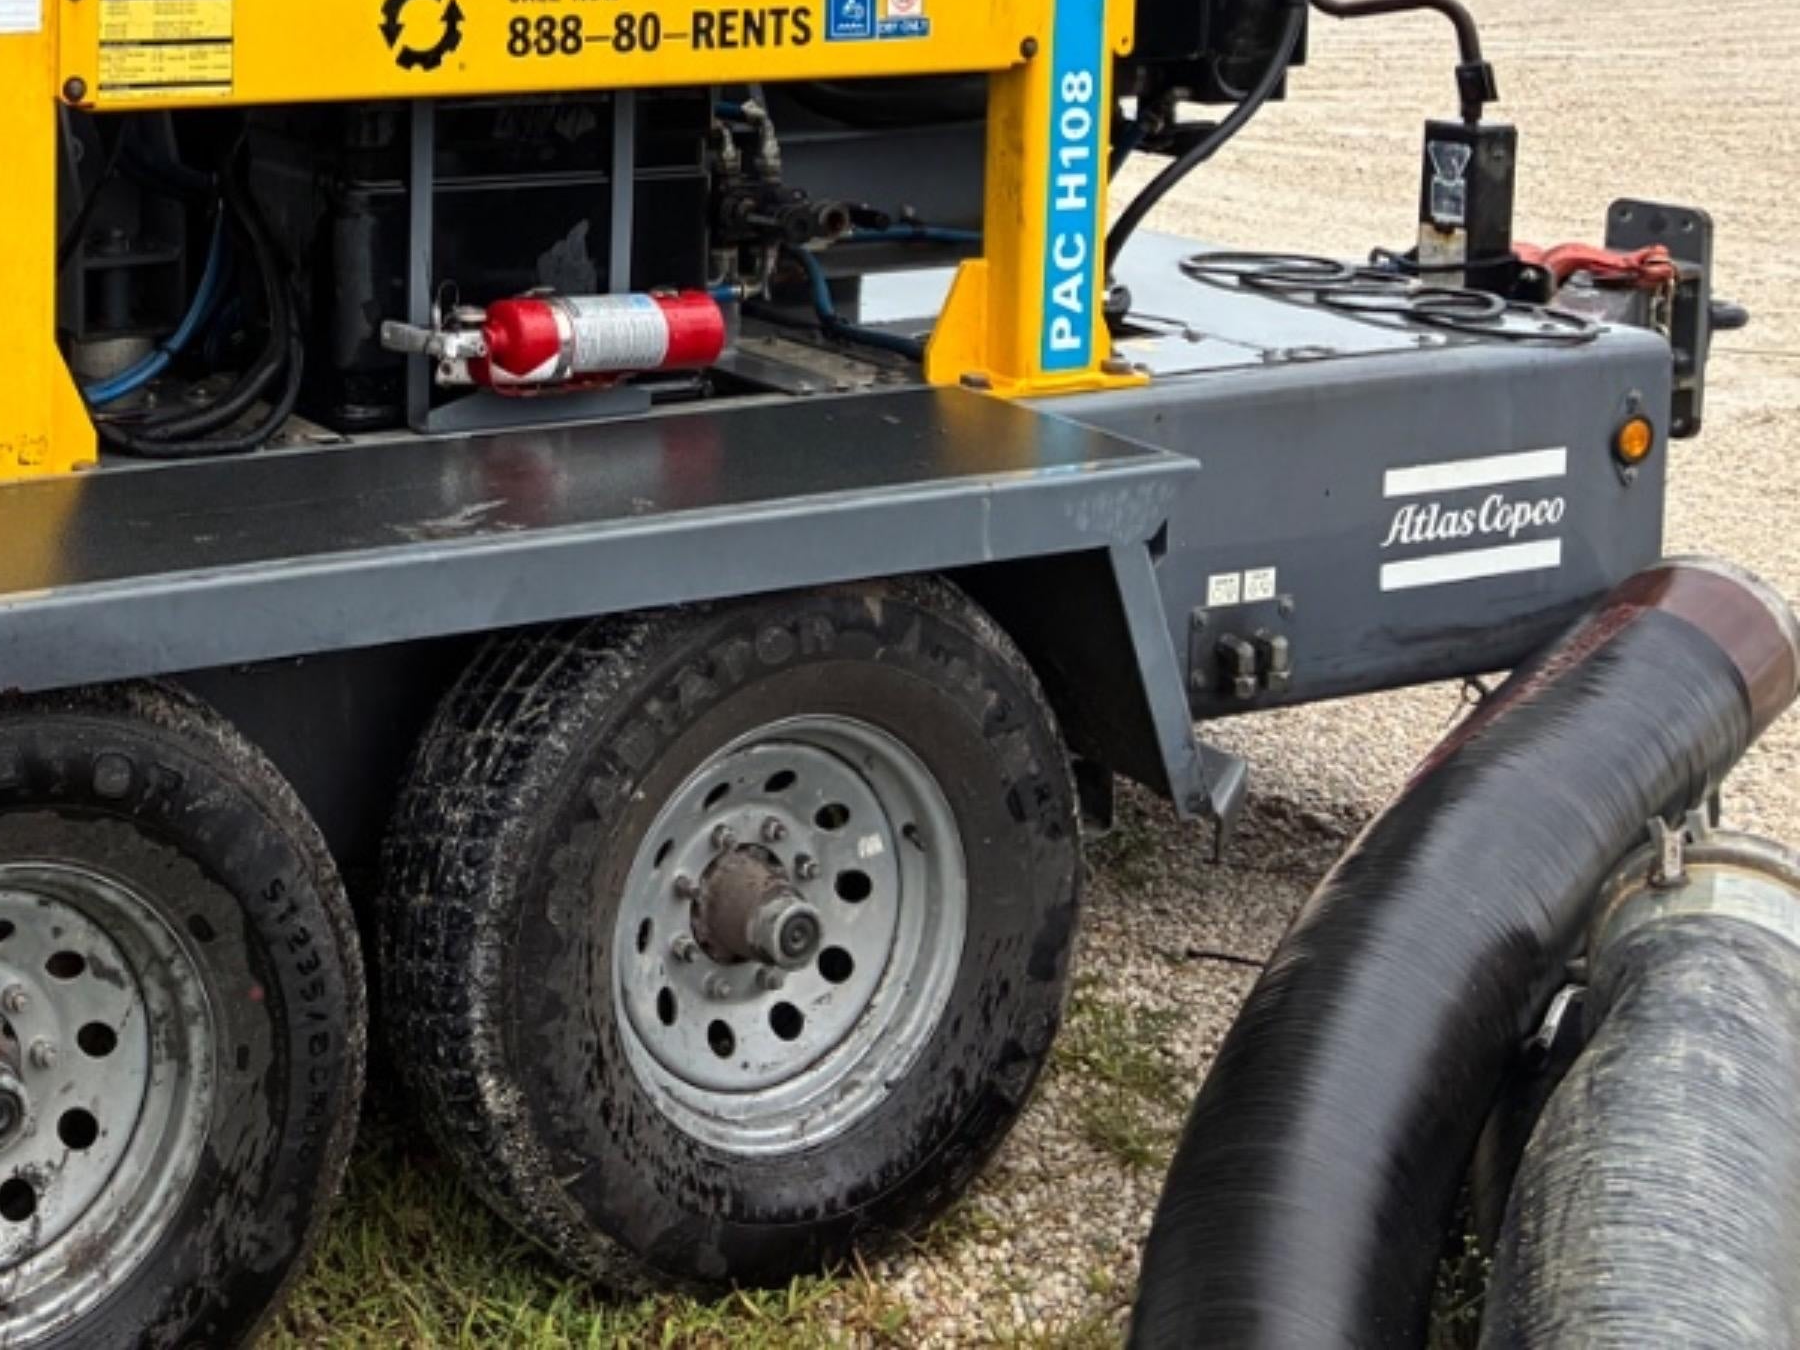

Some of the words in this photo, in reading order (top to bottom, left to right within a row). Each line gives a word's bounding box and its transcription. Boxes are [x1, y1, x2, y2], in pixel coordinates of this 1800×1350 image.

[1055, 70, 1093, 211] H108
[1049, 232, 1087, 352] PAC
[1380, 502, 1476, 547] Atlas
[1478, 493, 1566, 538] Copco
